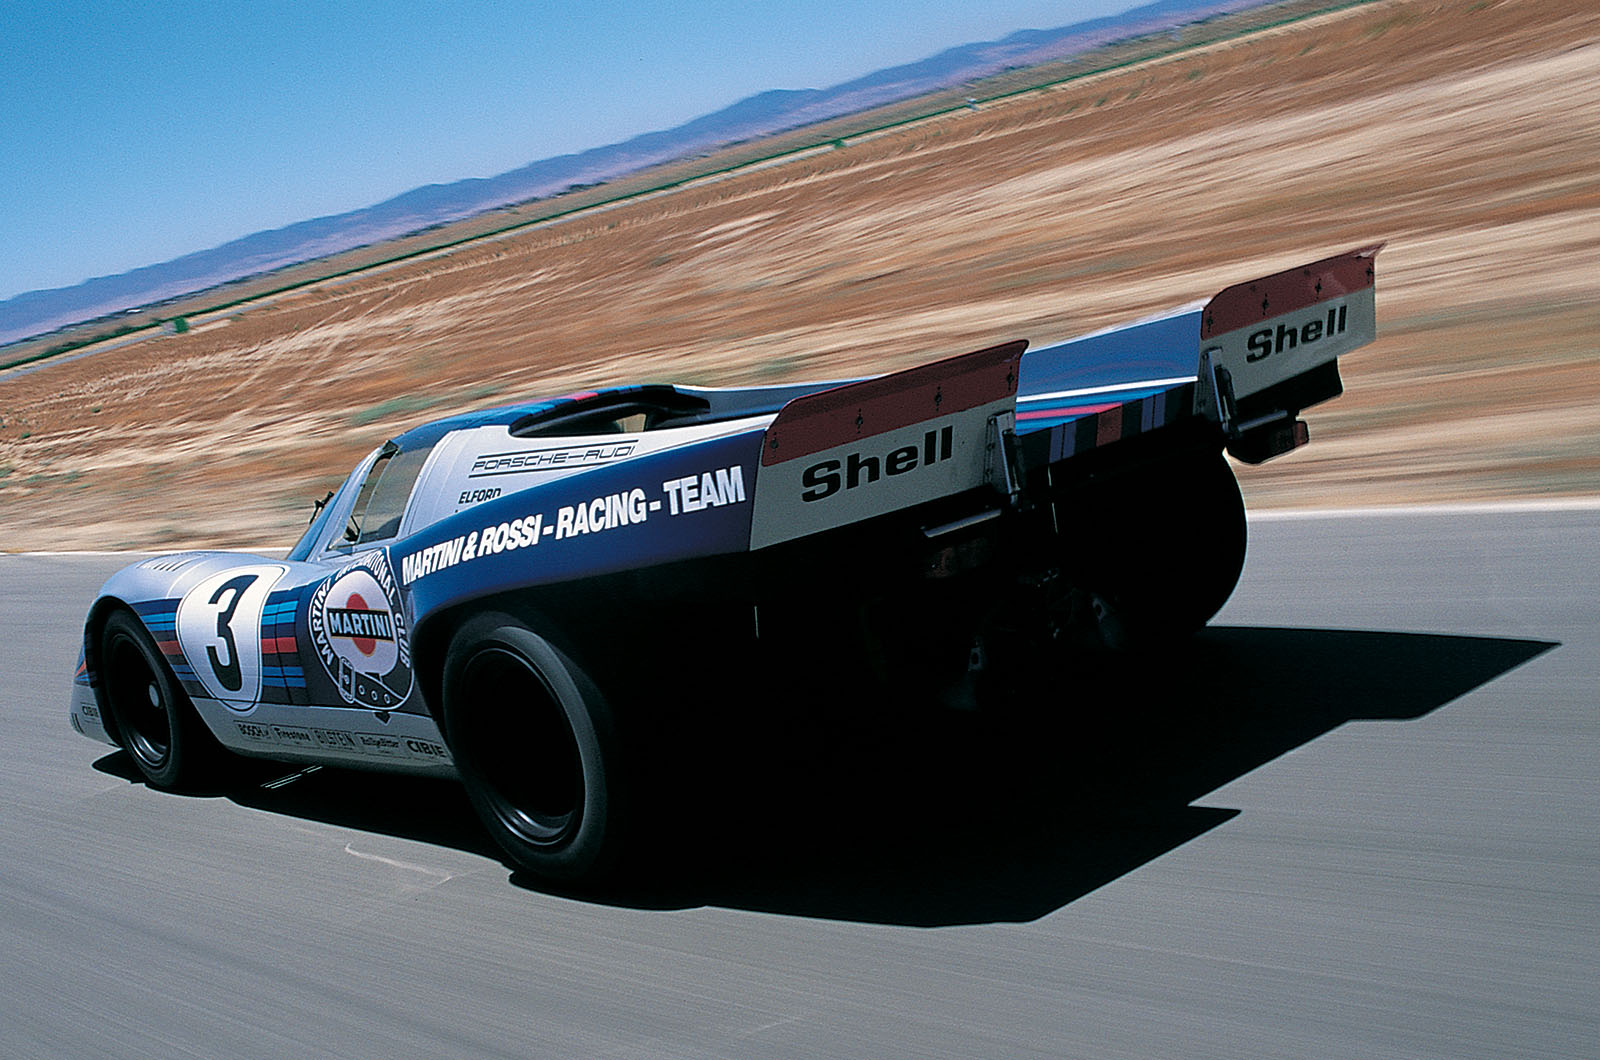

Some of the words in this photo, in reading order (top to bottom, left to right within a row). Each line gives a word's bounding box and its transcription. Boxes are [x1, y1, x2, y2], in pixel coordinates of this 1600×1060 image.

[1246, 305, 1348, 363] Shell
[801, 426, 953, 502] Shell
[402, 539, 466, 586] MARTINI
[663, 465, 746, 516] TEAM
[205, 574, 259, 692] 3
[312, 578, 334, 665] MARTINI
[328, 612, 392, 638] MARTINI
[406, 740, 447, 758] CIBIE
